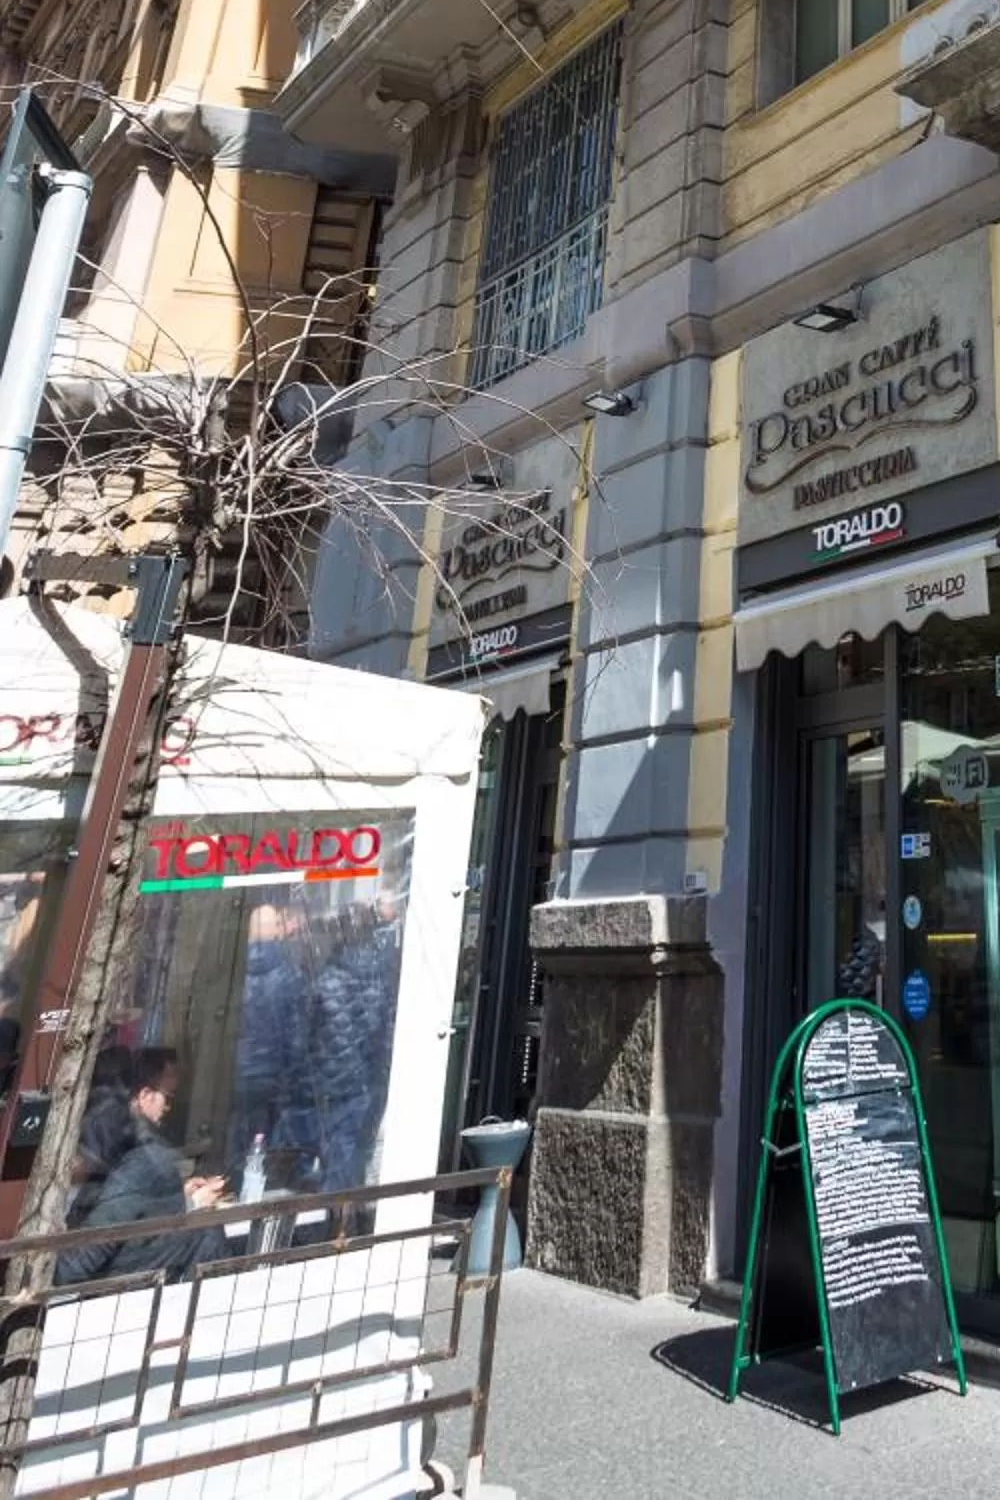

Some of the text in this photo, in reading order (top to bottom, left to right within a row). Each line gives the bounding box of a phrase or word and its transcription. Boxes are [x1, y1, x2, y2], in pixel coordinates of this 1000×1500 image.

[812, 503, 902, 551] TORALDO
[905, 573, 965, 606] TORALDO
[149, 827, 381, 877] TORALDO
